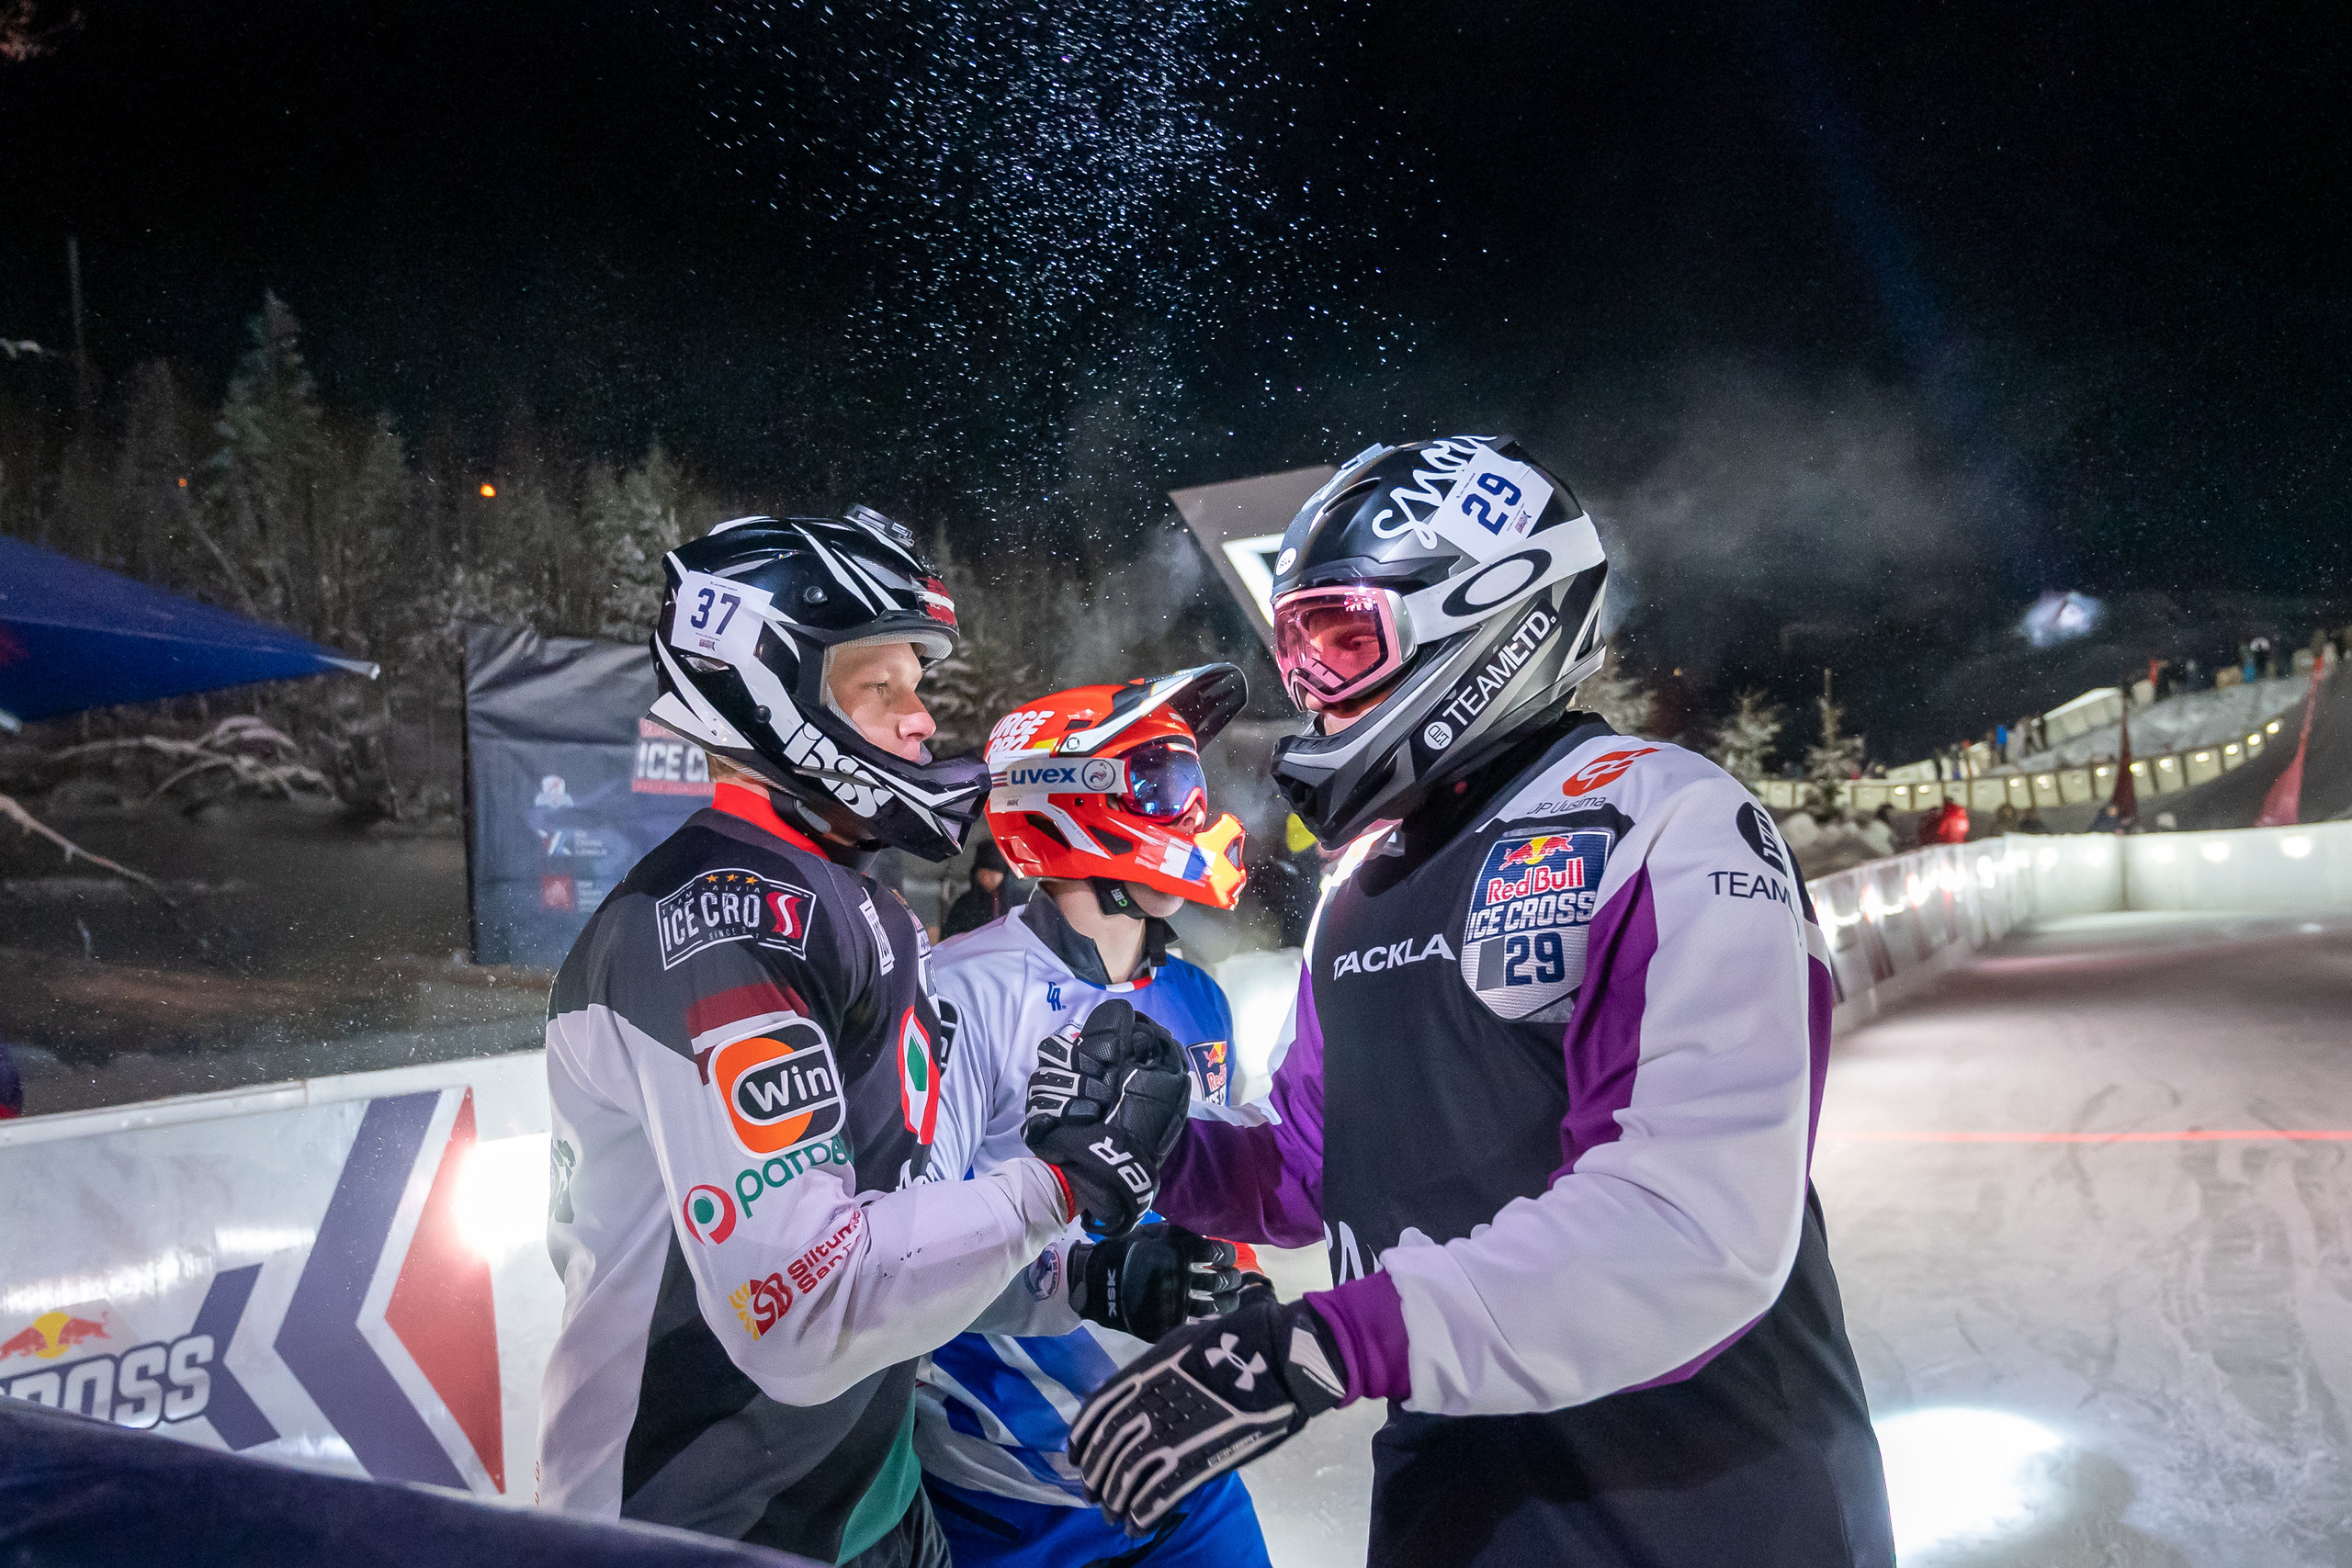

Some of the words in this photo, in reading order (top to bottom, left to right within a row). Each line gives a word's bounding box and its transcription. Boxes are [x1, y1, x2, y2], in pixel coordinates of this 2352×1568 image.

[1461, 472, 1522, 536] 29
[691, 588, 741, 636] 37
[637, 742, 684, 782] ICE
[1012, 767, 1077, 785] uvex
[1486, 865, 1532, 905] Red
[1532, 856, 1585, 894] Bull
[662, 897, 700, 952] ICE
[1467, 904, 1503, 941] ICE
[1503, 891, 1597, 932] CROSS
[1333, 933, 1457, 981] TACKLA
[1505, 932, 1566, 987] 29
